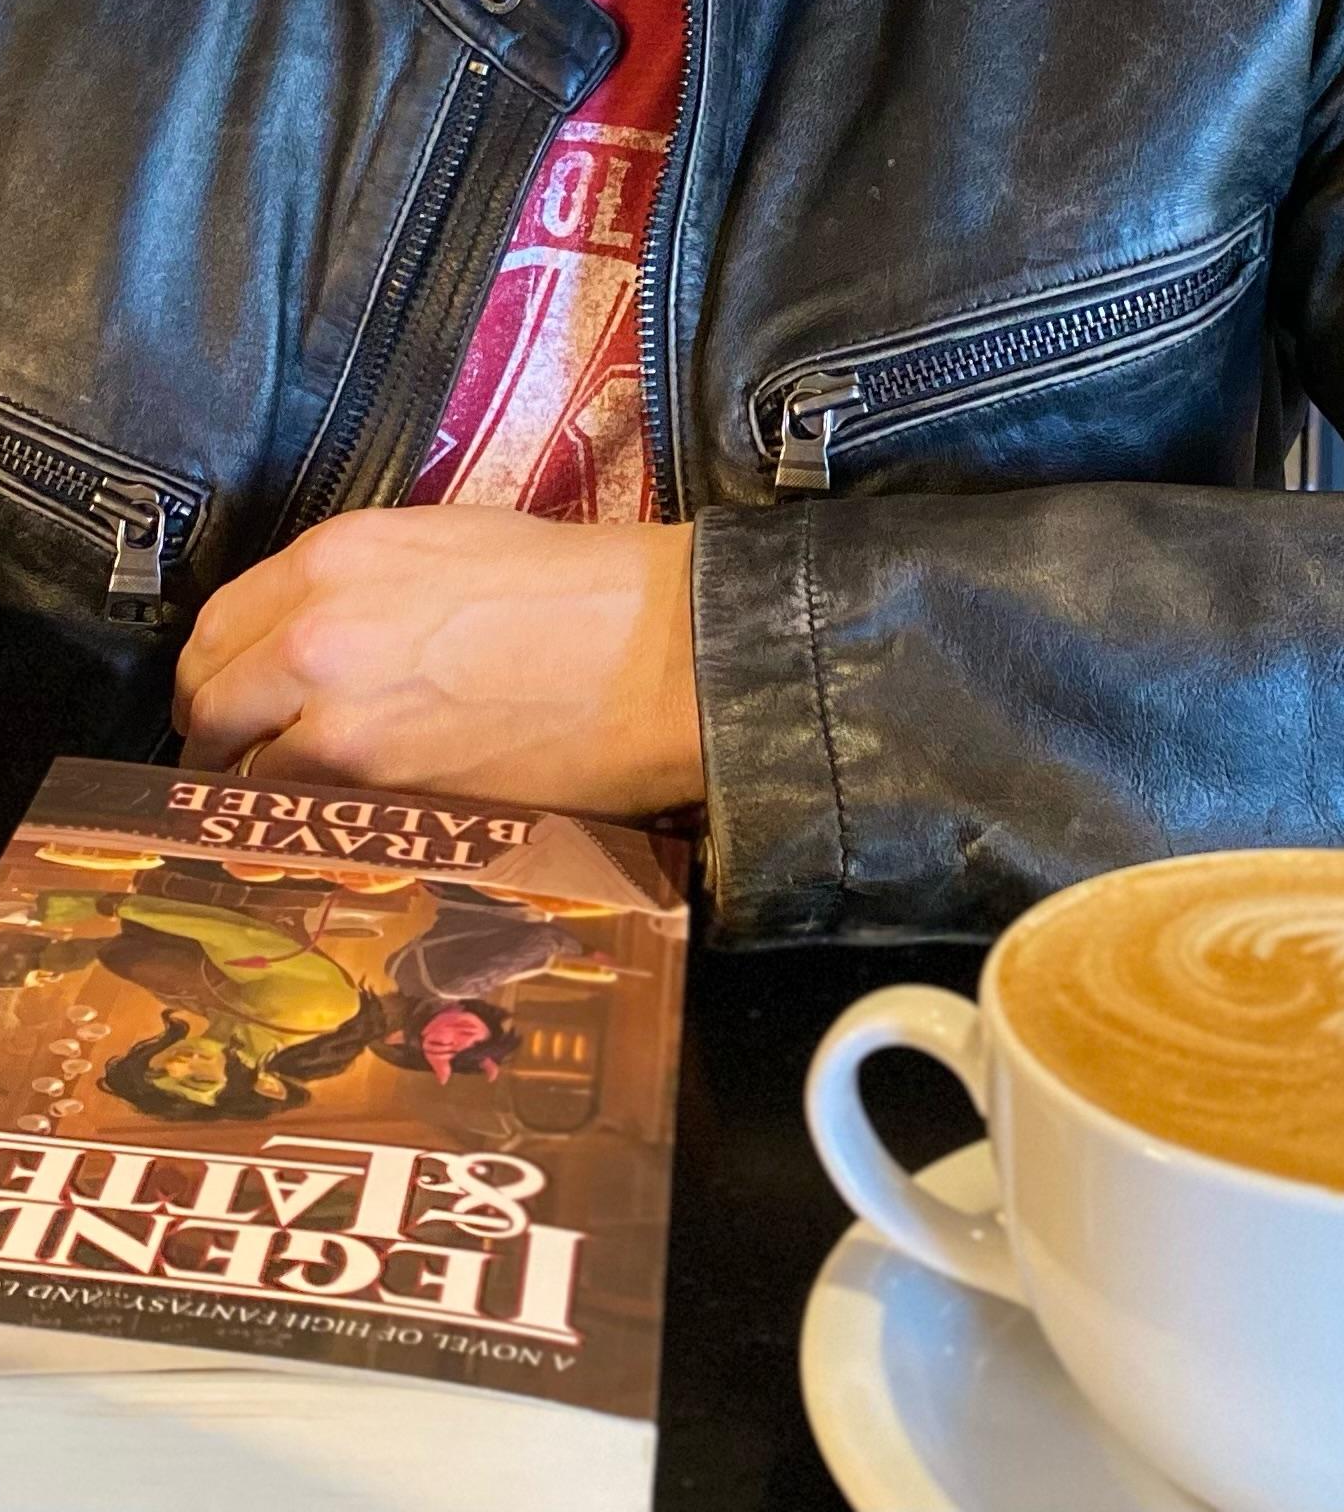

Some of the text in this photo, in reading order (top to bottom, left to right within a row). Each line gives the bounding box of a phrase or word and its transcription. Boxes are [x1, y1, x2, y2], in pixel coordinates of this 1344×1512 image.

[513, 150, 635, 250] OL
[167, 782, 532, 845] BALDREE
[200, 816, 487, 868] TRAVIS
[416, 1151, 547, 1239] &
[28, 1283, 103, 1305] AND
[124, 1294, 278, 1326] FANTASY
[286, 1313, 372, 1340] HIGH
[378, 1323, 425, 1346] OF
[433, 1332, 544, 1368] NOVEL
[555, 1352, 576, 1373] A
